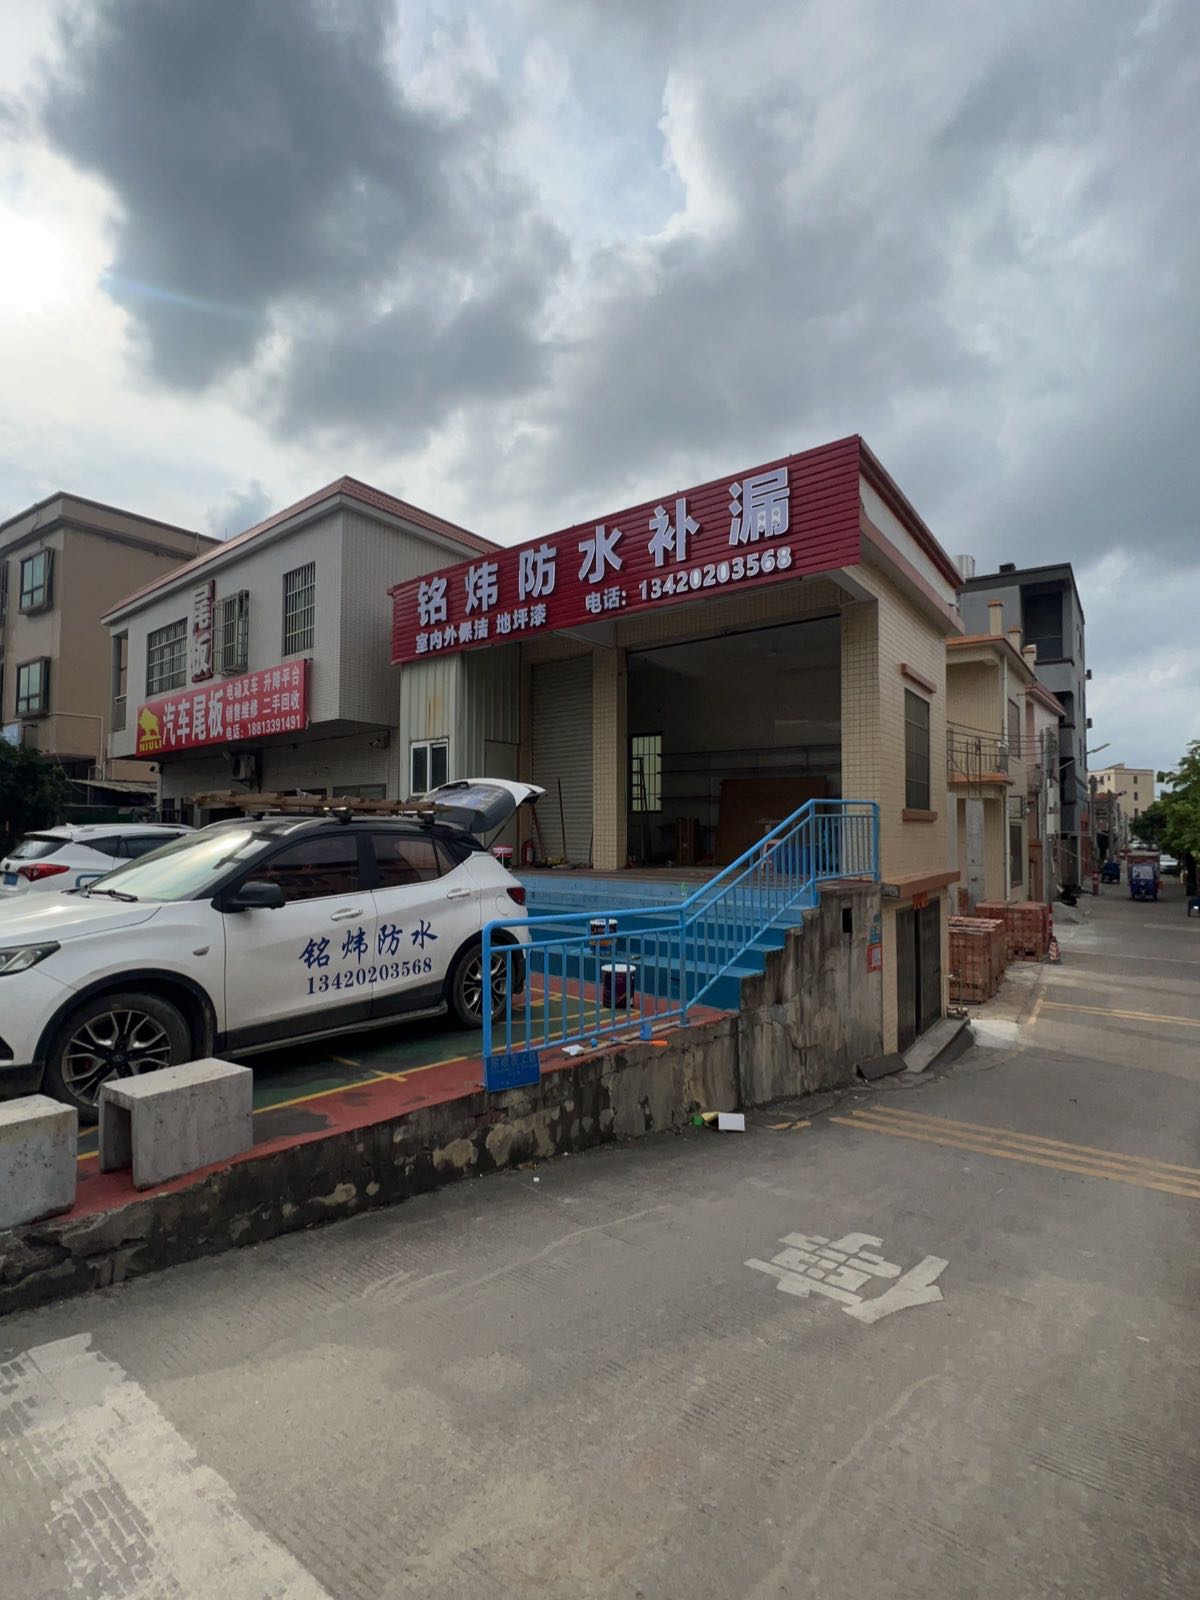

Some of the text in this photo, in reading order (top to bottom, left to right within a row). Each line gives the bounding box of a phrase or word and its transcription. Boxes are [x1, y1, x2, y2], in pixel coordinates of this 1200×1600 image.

[417, 467, 791, 627] 铭炜防水补漏
[638, 546, 793, 602] 13420203568
[415, 603, 547, 654] 室内外保洁 地坪漆
[226, 665, 300, 700] 电动叉车 升降平台
[263, 690, 300, 715] 二手回收
[162, 688, 225, 747] 汽车尾板
[247, 714, 301, 736] 18813391491
[299, 919, 439, 969] 铭炜防水
[306, 957, 433, 995] 13420203568
